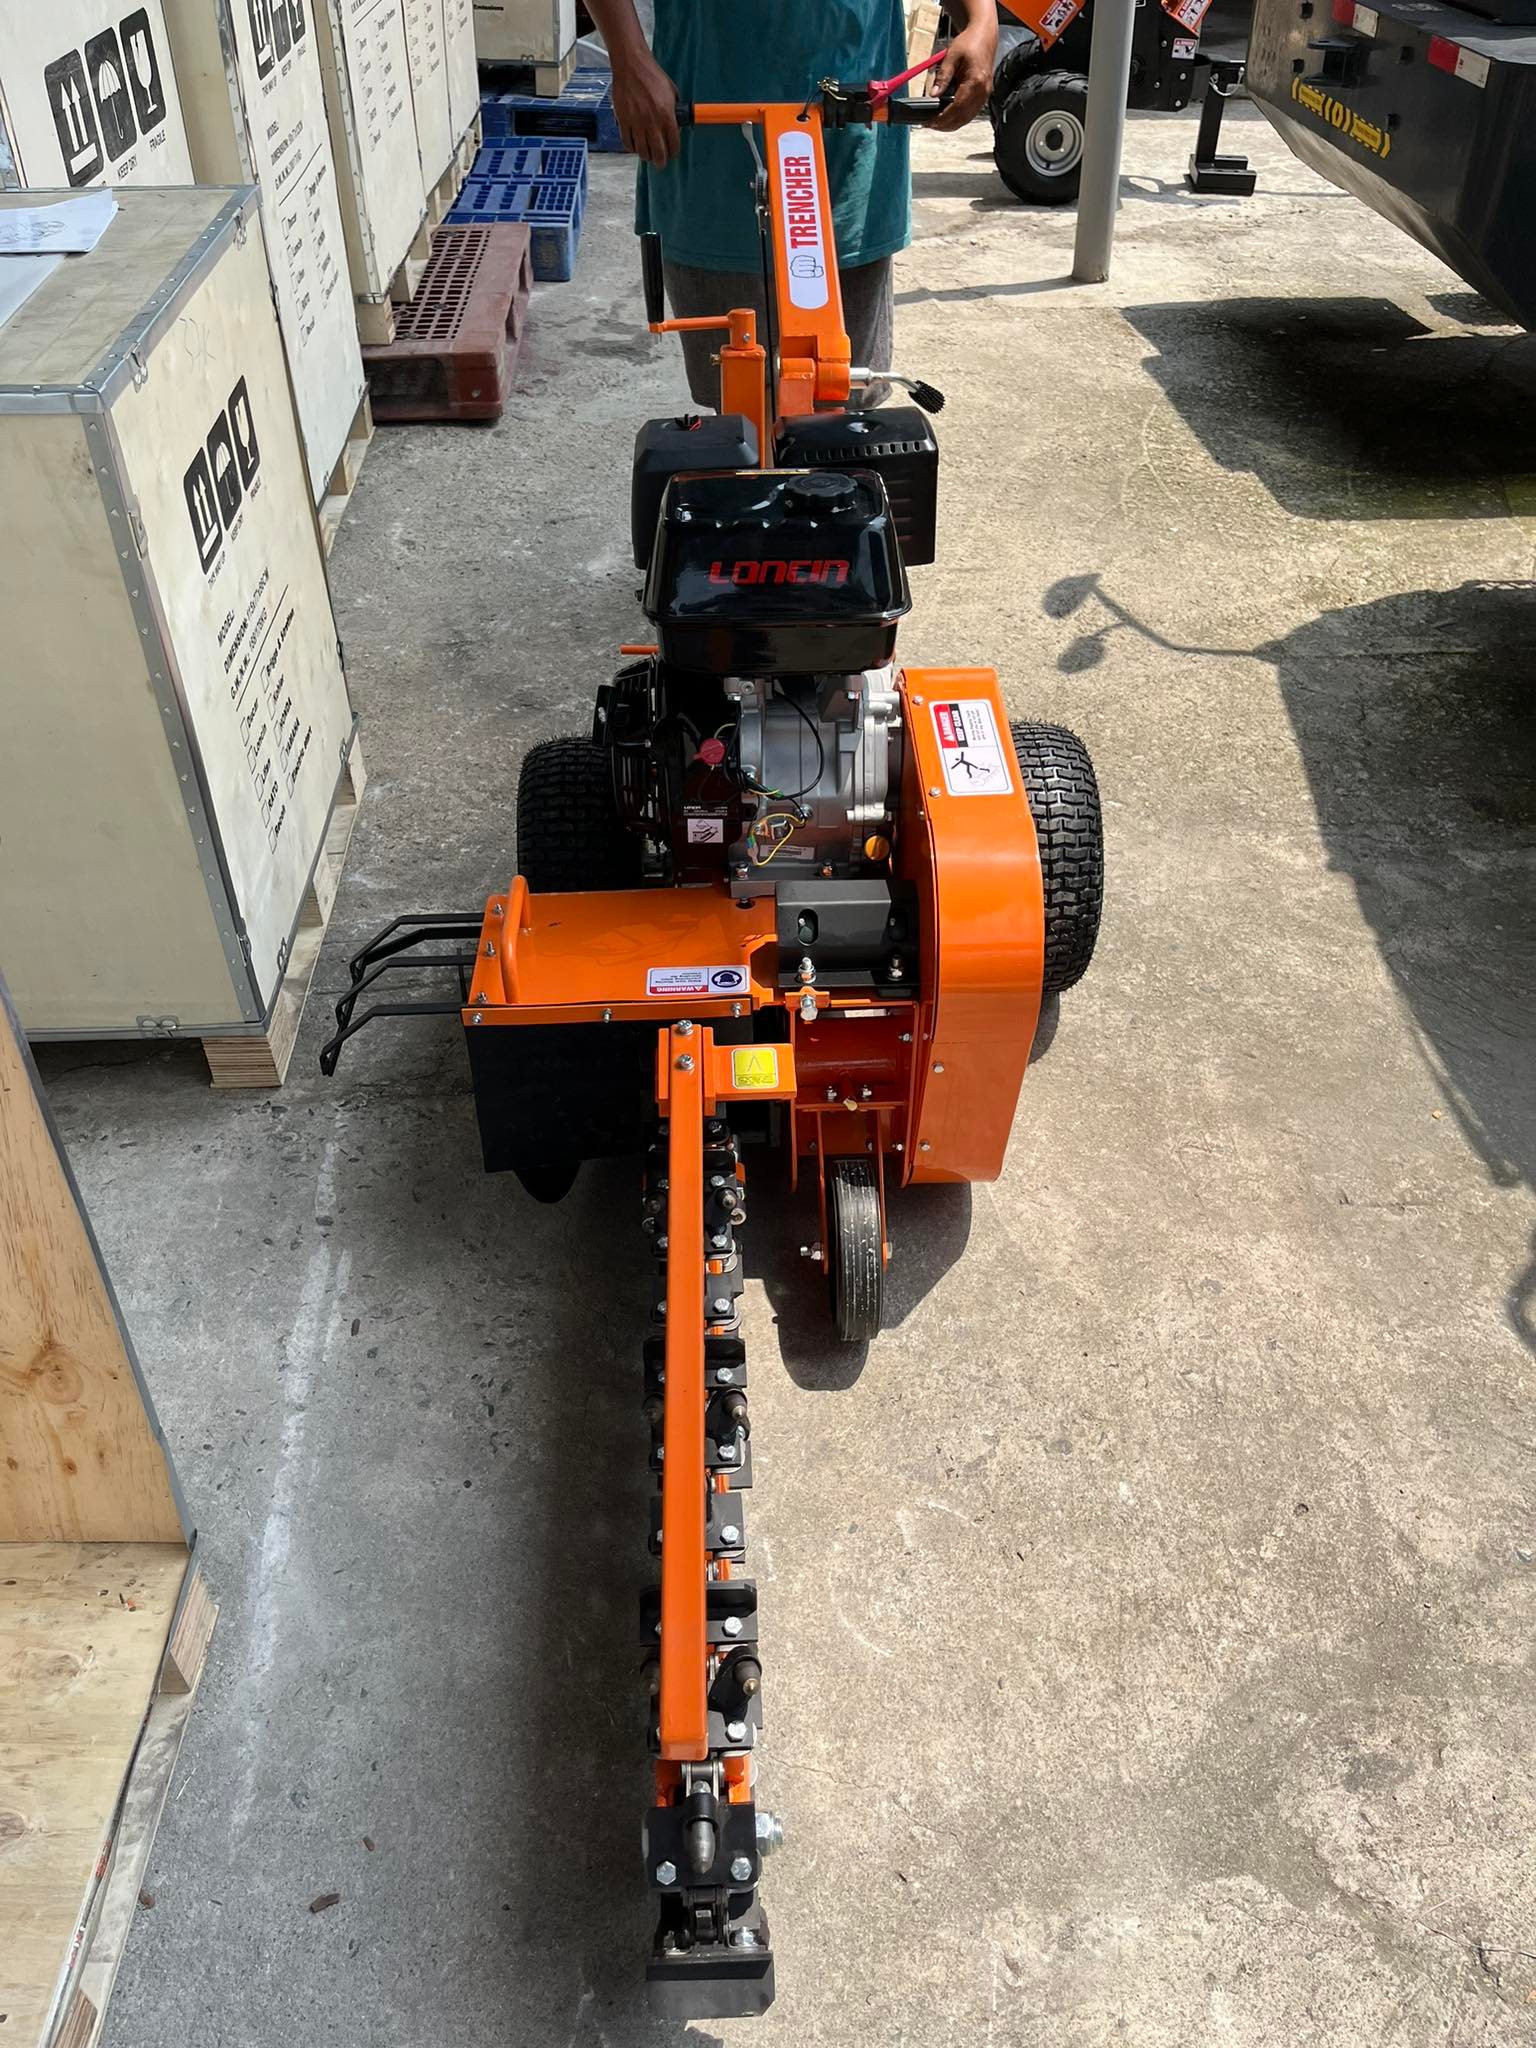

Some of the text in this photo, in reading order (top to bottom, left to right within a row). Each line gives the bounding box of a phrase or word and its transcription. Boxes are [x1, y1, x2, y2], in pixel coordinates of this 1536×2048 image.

[148, 129, 166, 153] FRAGILE
[117, 153, 138, 180] KEEP DRY
[784, 156, 818, 249] TRENCHER
[708, 559, 850, 585] LONCIN
[247, 697, 258, 729] Ducar
[951, 710, 966, 742] KEEP CLEAR
[253, 723, 267, 757] Loncin
[267, 780, 279, 812] RATO
[656, 985, 694, 993] WARNING
